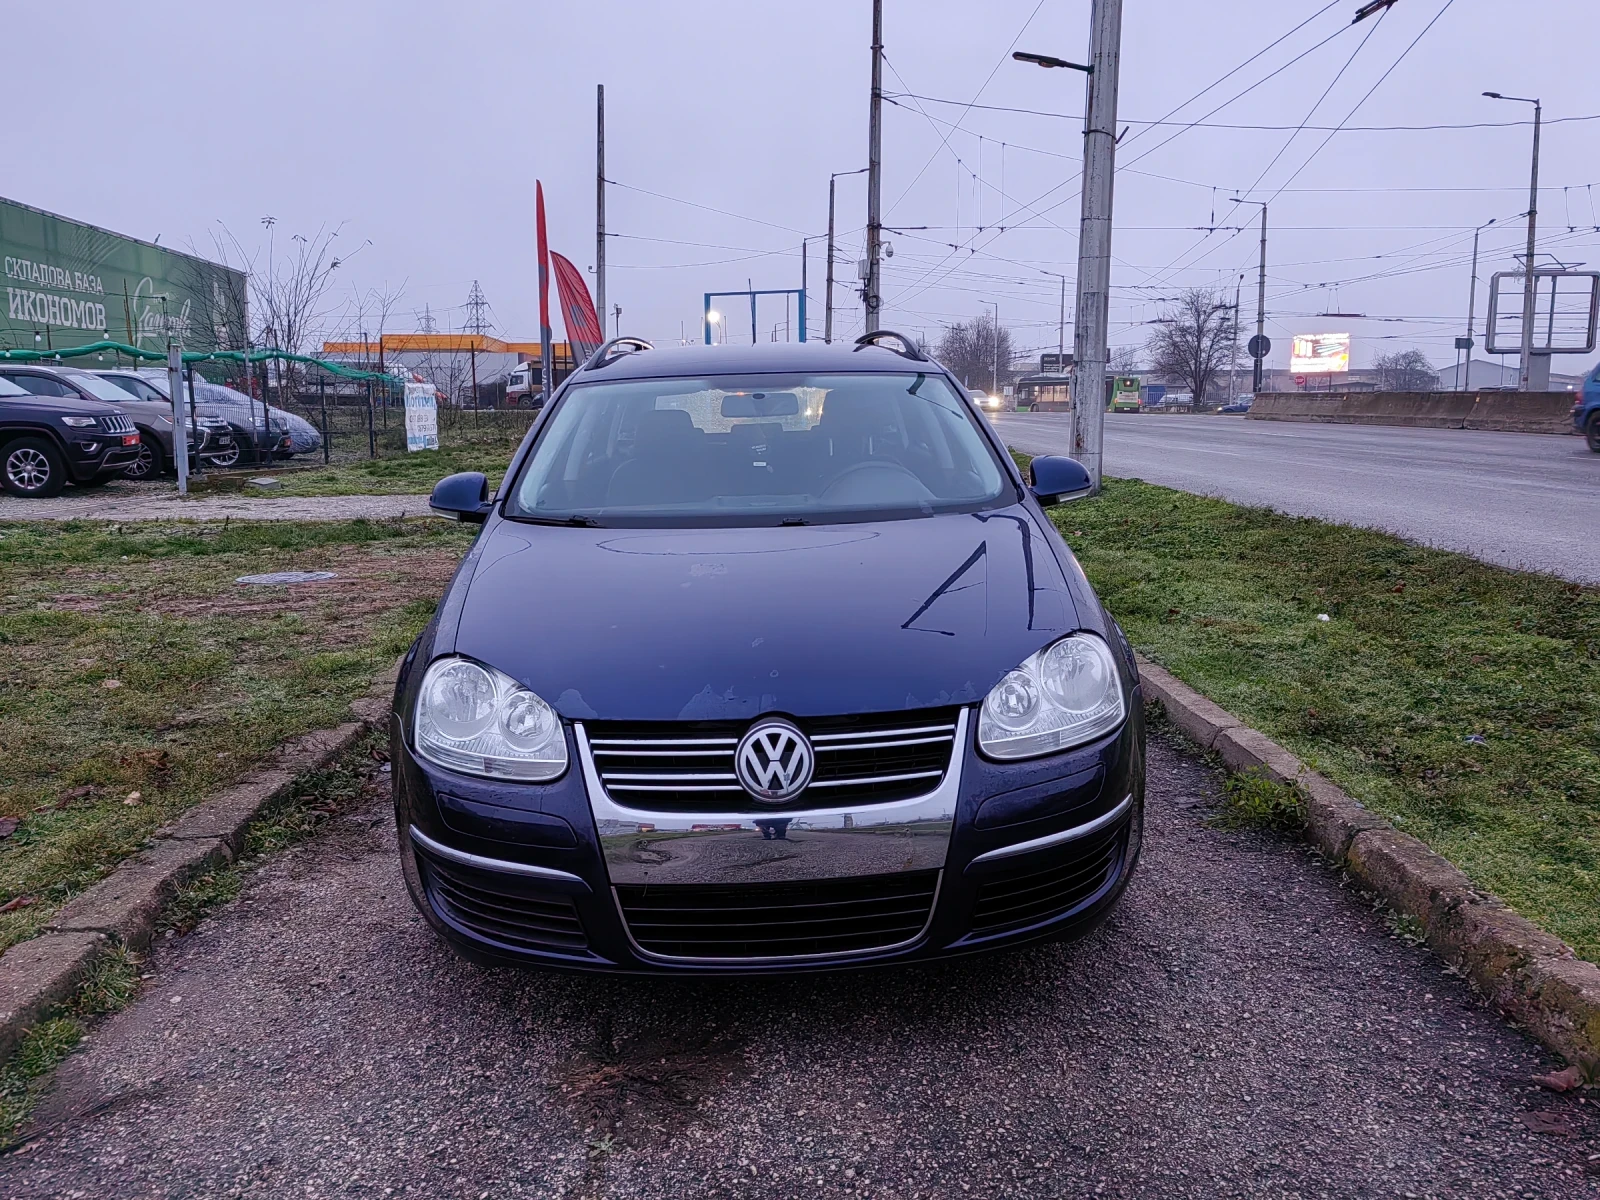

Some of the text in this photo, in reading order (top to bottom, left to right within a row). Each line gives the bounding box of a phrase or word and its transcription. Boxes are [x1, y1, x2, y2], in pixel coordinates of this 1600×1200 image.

[4, 255, 104, 295] СКЛАДОВА БАЗА
[7, 287, 106, 330] ИКОНОМОВ
[737, 724, 812, 799] VW
